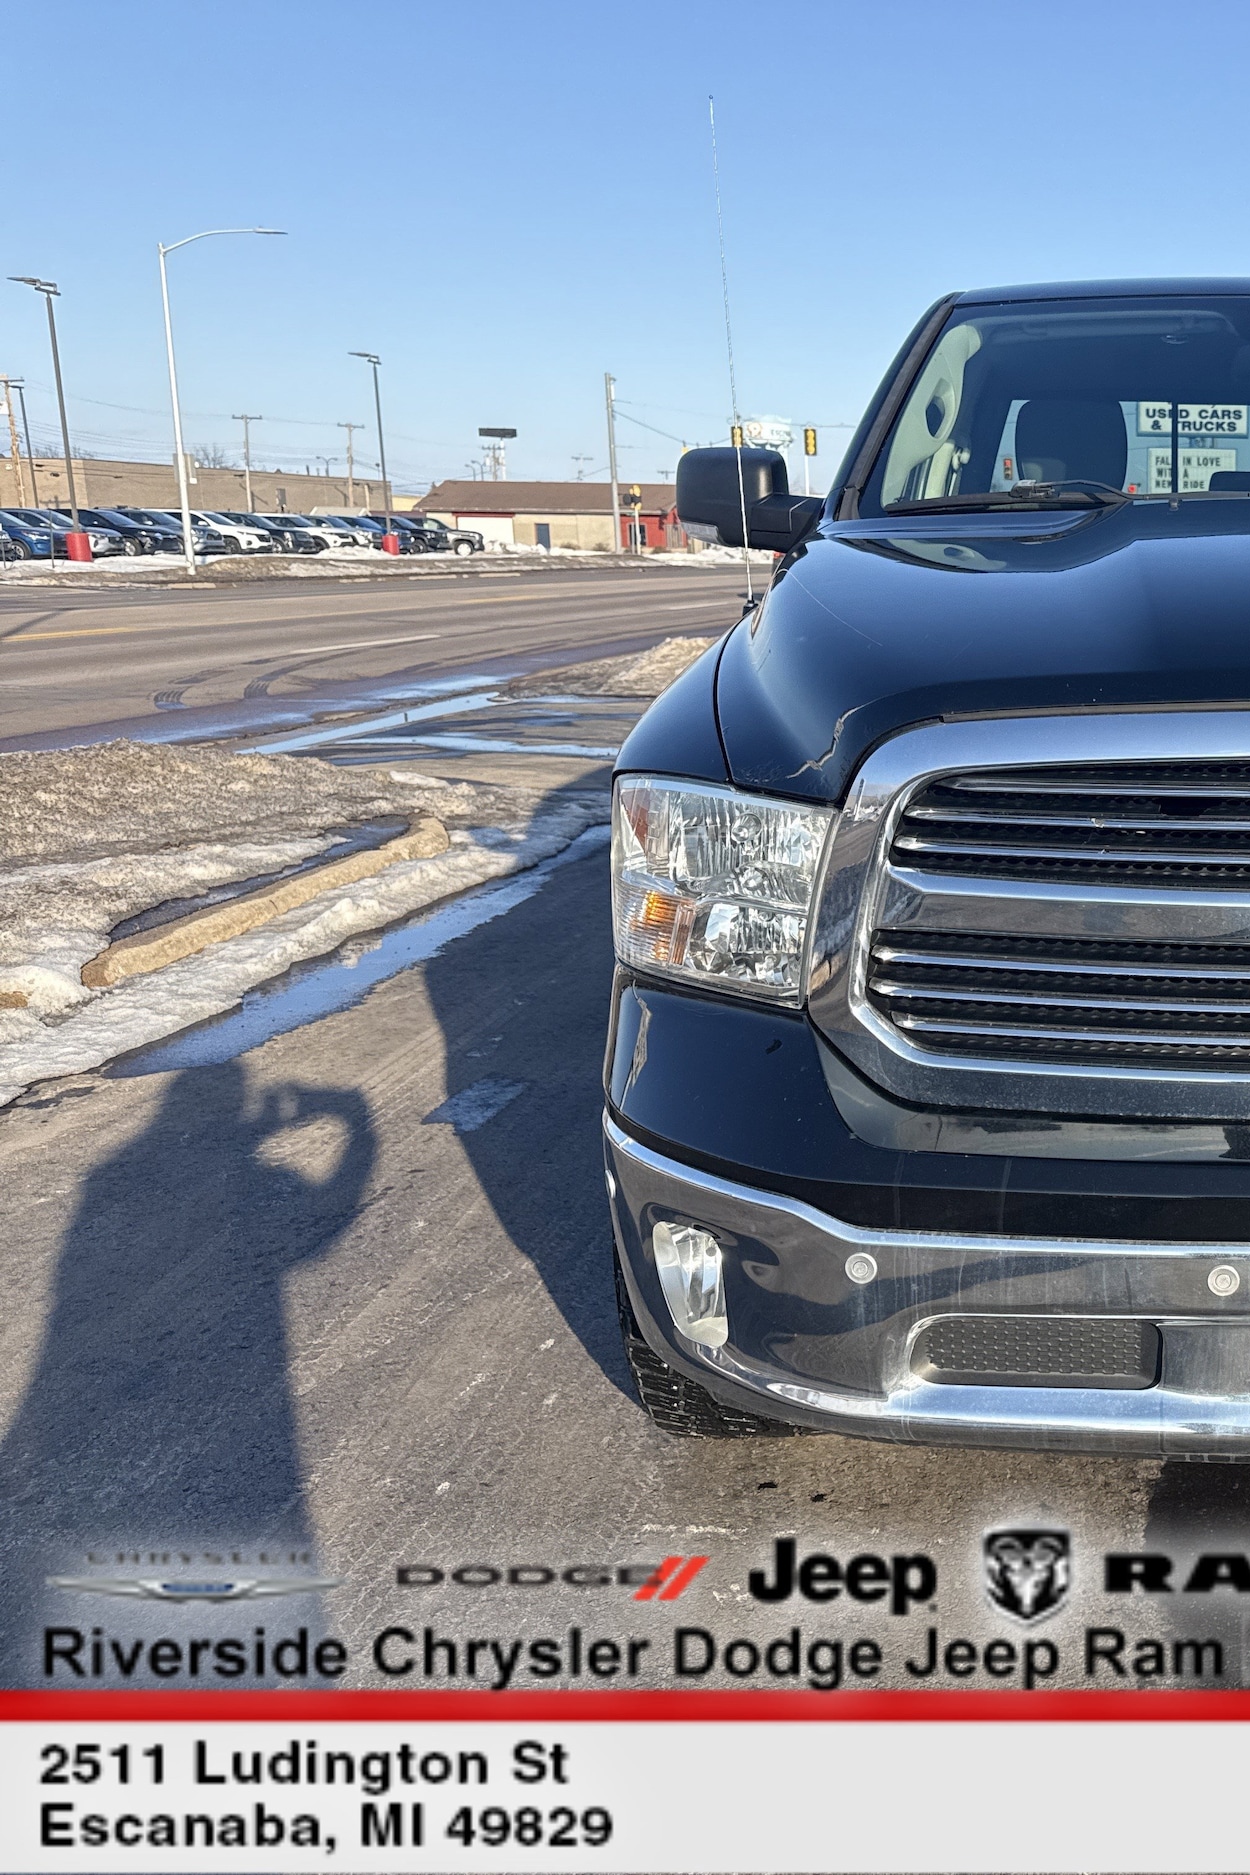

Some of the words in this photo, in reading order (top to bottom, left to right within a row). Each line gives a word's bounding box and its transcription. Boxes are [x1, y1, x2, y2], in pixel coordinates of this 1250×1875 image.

[1198, 409, 1242, 420] CARS
[1151, 420, 1161, 430] &
[1183, 457, 1192, 466] IN
[1197, 457, 1221, 467] LOVE
[1183, 468, 1189, 479] A
[1183, 481, 1205, 489] RIDE
